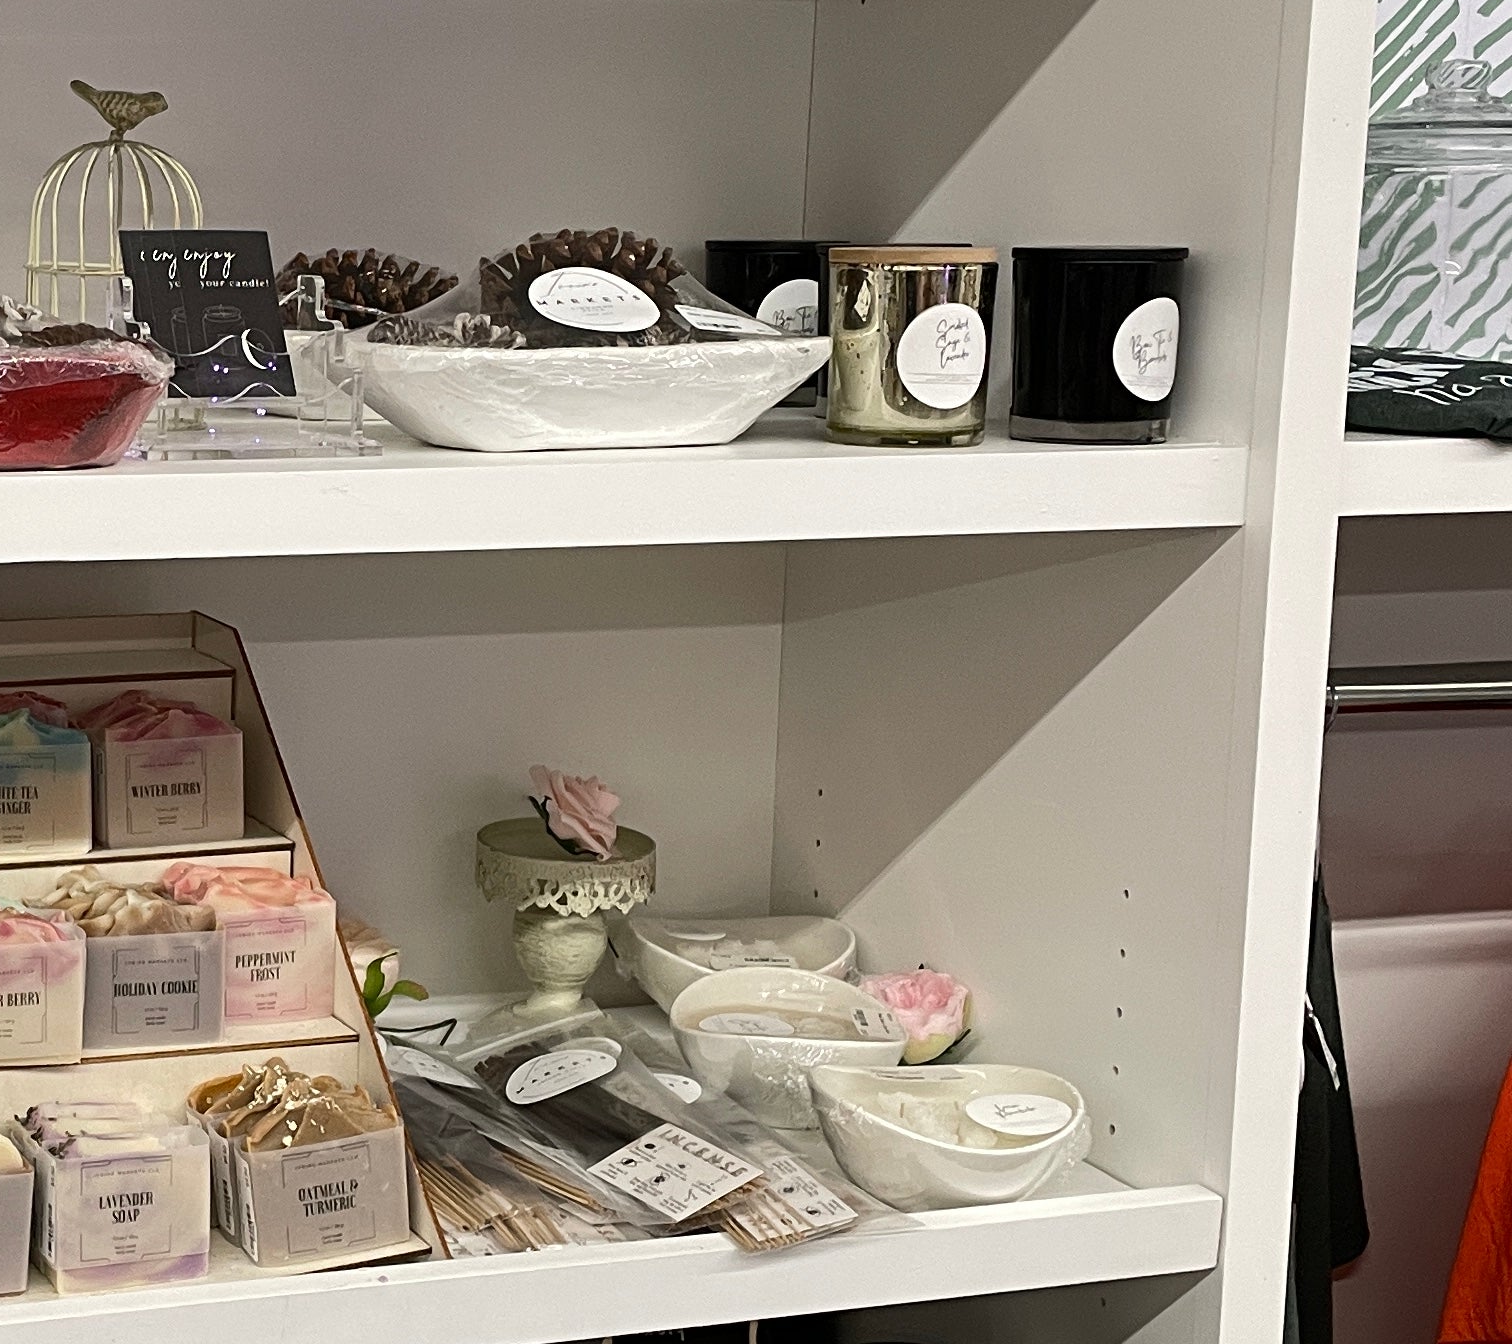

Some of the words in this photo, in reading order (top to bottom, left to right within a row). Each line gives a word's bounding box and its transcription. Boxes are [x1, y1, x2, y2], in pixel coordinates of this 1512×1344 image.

[199, 279, 226, 290] your
[229, 278, 270, 288] candle!
[21, 785, 39, 799] TEA
[131, 783, 168, 799] WINTER
[171, 781, 201, 797] BERRY
[235, 950, 296, 968] PEPPERMINT
[250, 966, 281, 982] FROST
[113, 982, 157, 997] HOLIDAY
[161, 980, 199, 995] COOKIE
[6, 991, 42, 1007] BERRY
[298, 1180, 346, 1202] OATMEAL
[349, 1178, 359, 1193] &
[99, 1191, 154, 1210] LAVENDER
[302, 1194, 357, 1217] TURMERIC
[111, 1208, 141, 1225] SOAP
